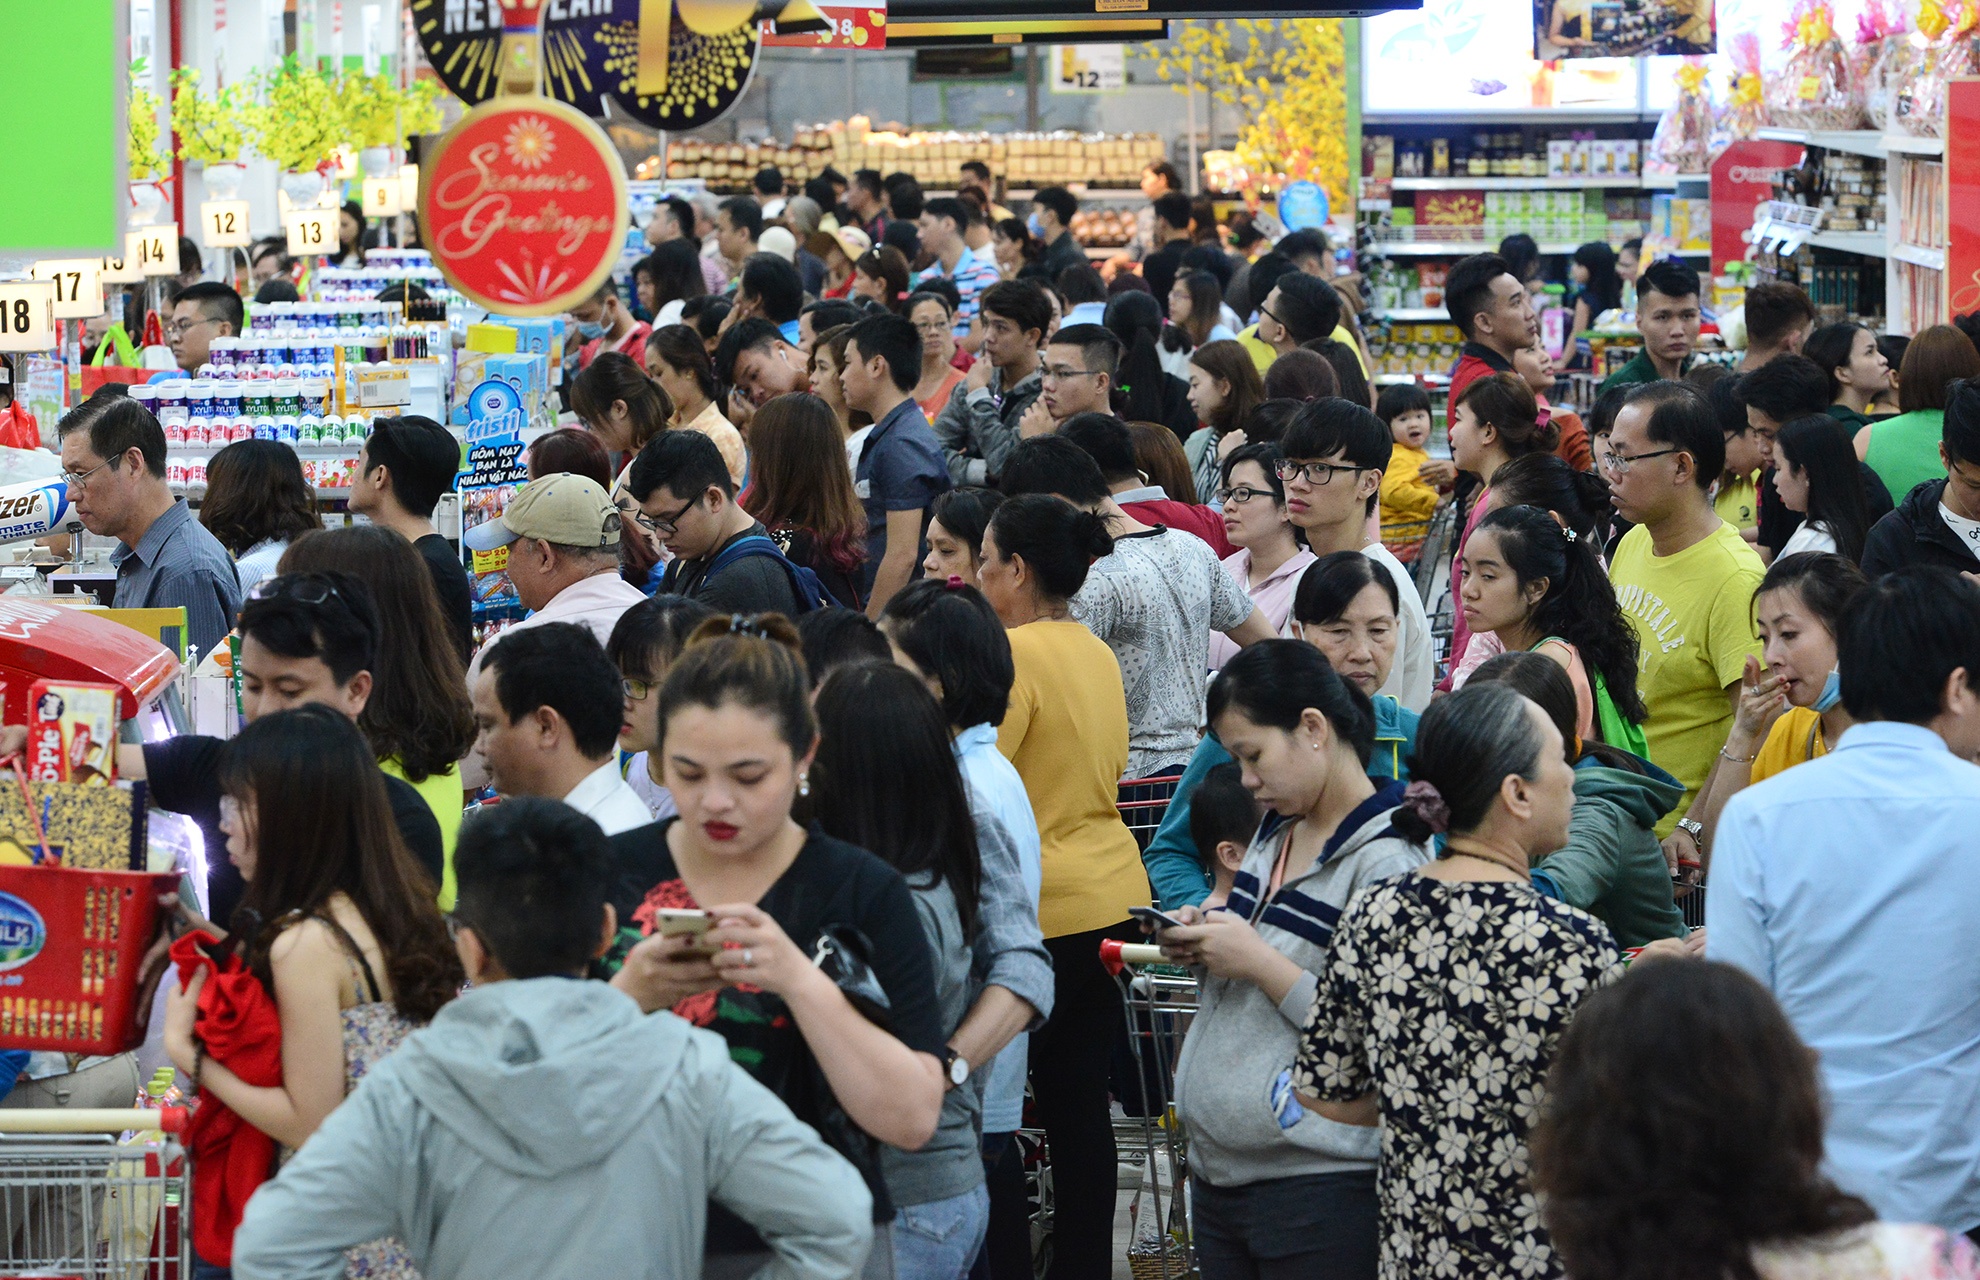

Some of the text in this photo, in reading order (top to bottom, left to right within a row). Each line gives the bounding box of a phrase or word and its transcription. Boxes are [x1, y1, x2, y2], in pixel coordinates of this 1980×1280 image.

[377, 188, 387, 207] 9
[214, 212, 236, 234] 12
[300, 221, 322, 244] 13
[436, 193, 613, 260] Greetings
[143, 238, 164, 262] 14
[52, 272, 81, 302] 17
[0, 299, 30, 333] 18
[466, 408, 520, 441] fristi
[471, 445, 521, 461] HÔM NAY
[476, 456, 514, 472] BẠN LÀ
[459, 472, 487, 486] NHÂN
[489, 469, 506, 484] VẬT
